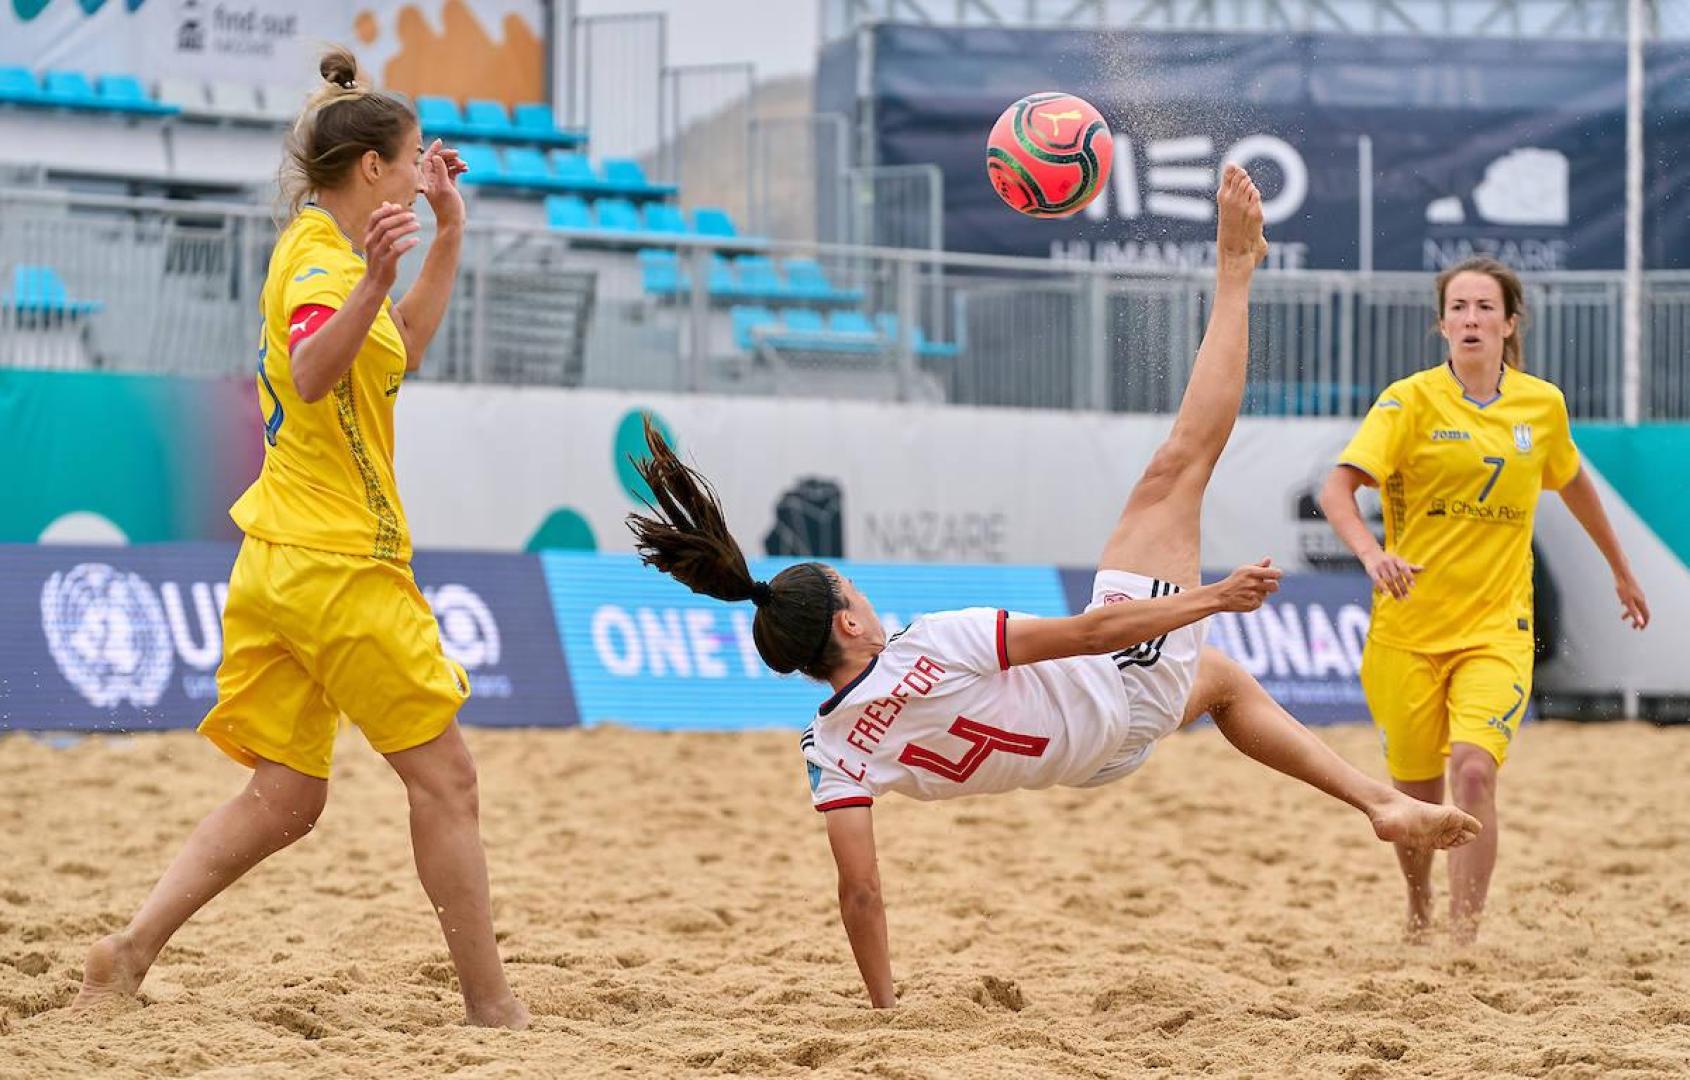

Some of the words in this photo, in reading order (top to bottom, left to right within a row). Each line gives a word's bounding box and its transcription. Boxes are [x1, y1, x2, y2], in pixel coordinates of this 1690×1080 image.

[1478, 456, 1505, 502] 7
[592, 604, 727, 677] ONE
[1503, 684, 1525, 721] 7
[897, 715, 1050, 783] 4
